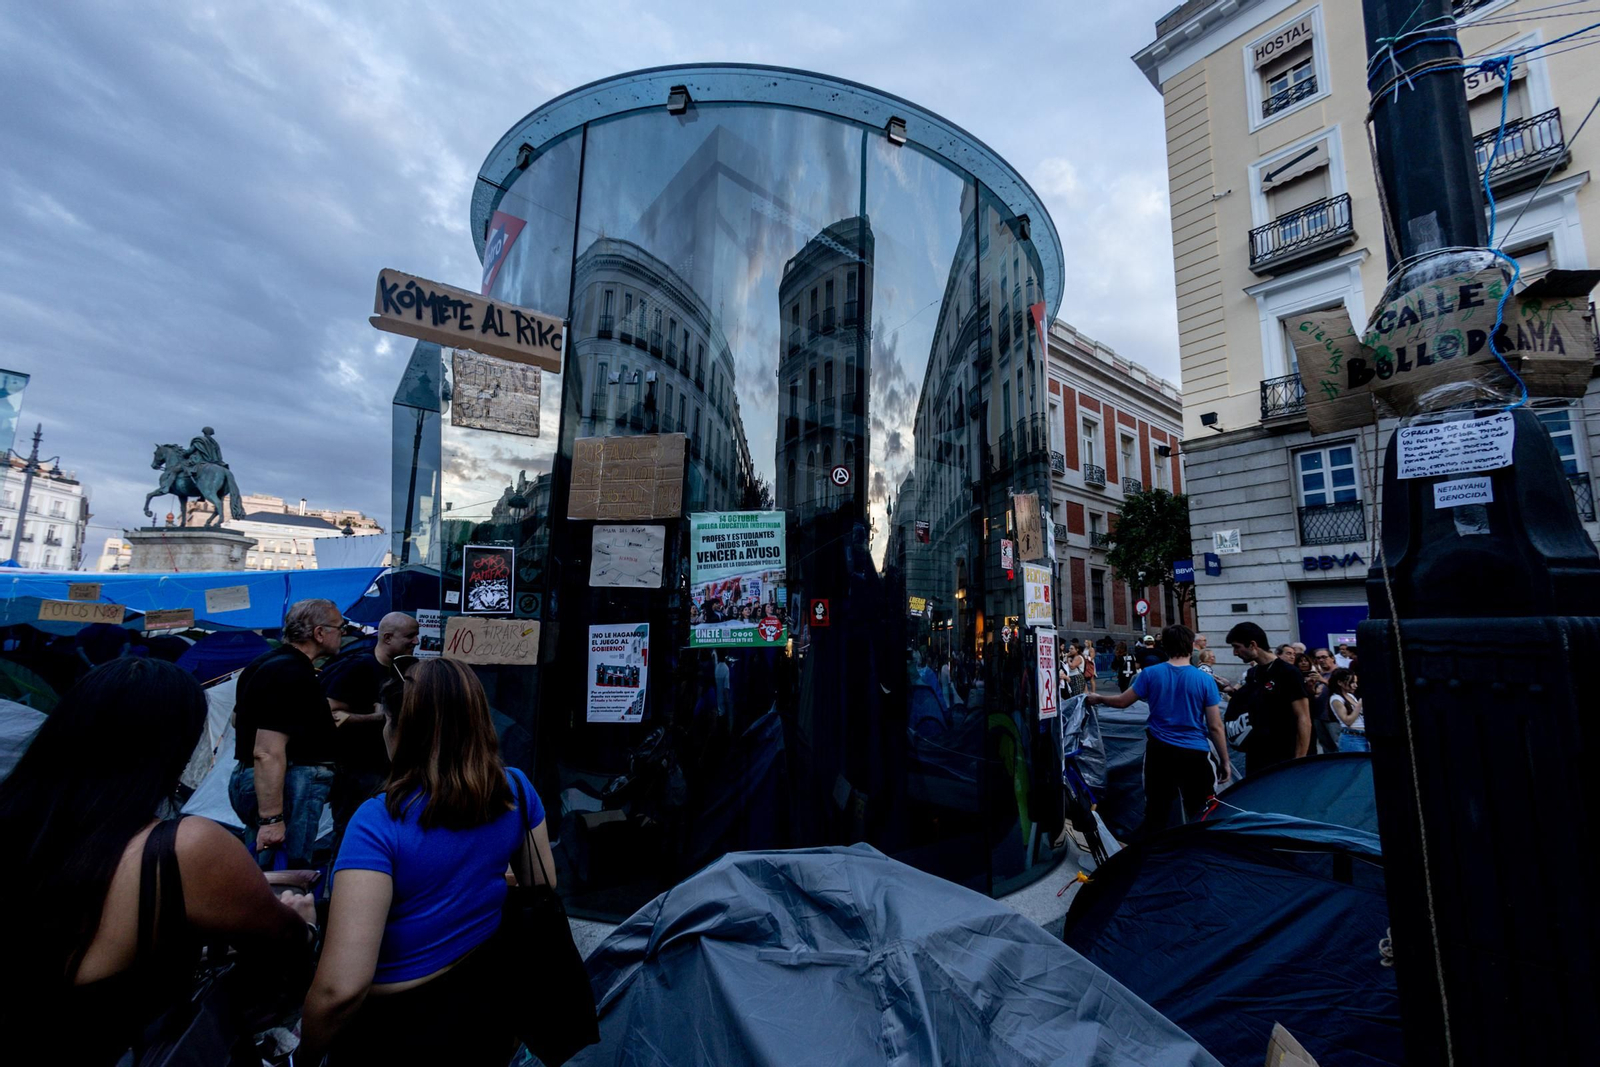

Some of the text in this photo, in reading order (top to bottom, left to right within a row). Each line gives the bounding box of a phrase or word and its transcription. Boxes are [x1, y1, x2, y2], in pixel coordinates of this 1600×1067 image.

[1256, 22, 1310, 61] HOSTAL
[1376, 282, 1485, 334] CALLE
[481, 303, 511, 337] AL
[1401, 428, 1440, 438] GRACIAS
[1462, 420, 1492, 429] LUCHAR
[1416, 436, 1444, 444] FUTURO
[1447, 431, 1477, 439] MEJOR
[1418, 448, 1449, 457] QUIENES
[1463, 440, 1494, 449] PODEMOS
[1462, 446, 1500, 455] VOSOTRAS
[1437, 482, 1487, 493] NETANYAHU
[1439, 491, 1488, 502] GENOCIDA
[728, 514, 759, 522] OCTUBRE
[702, 534, 726, 543] PROFES
[732, 531, 775, 540] ESTUDIANTES
[716, 541, 740, 550] UNIDOS
[697, 546, 781, 564] VENCER A AYUSO
[1303, 551, 1366, 571] BBVA
[1175, 567, 1196, 575] BBVA
[43, 601, 88, 618] FOTOS
[448, 627, 475, 654] NO
[481, 624, 519, 643] TIRAR
[1226, 712, 1250, 739] NIKE
